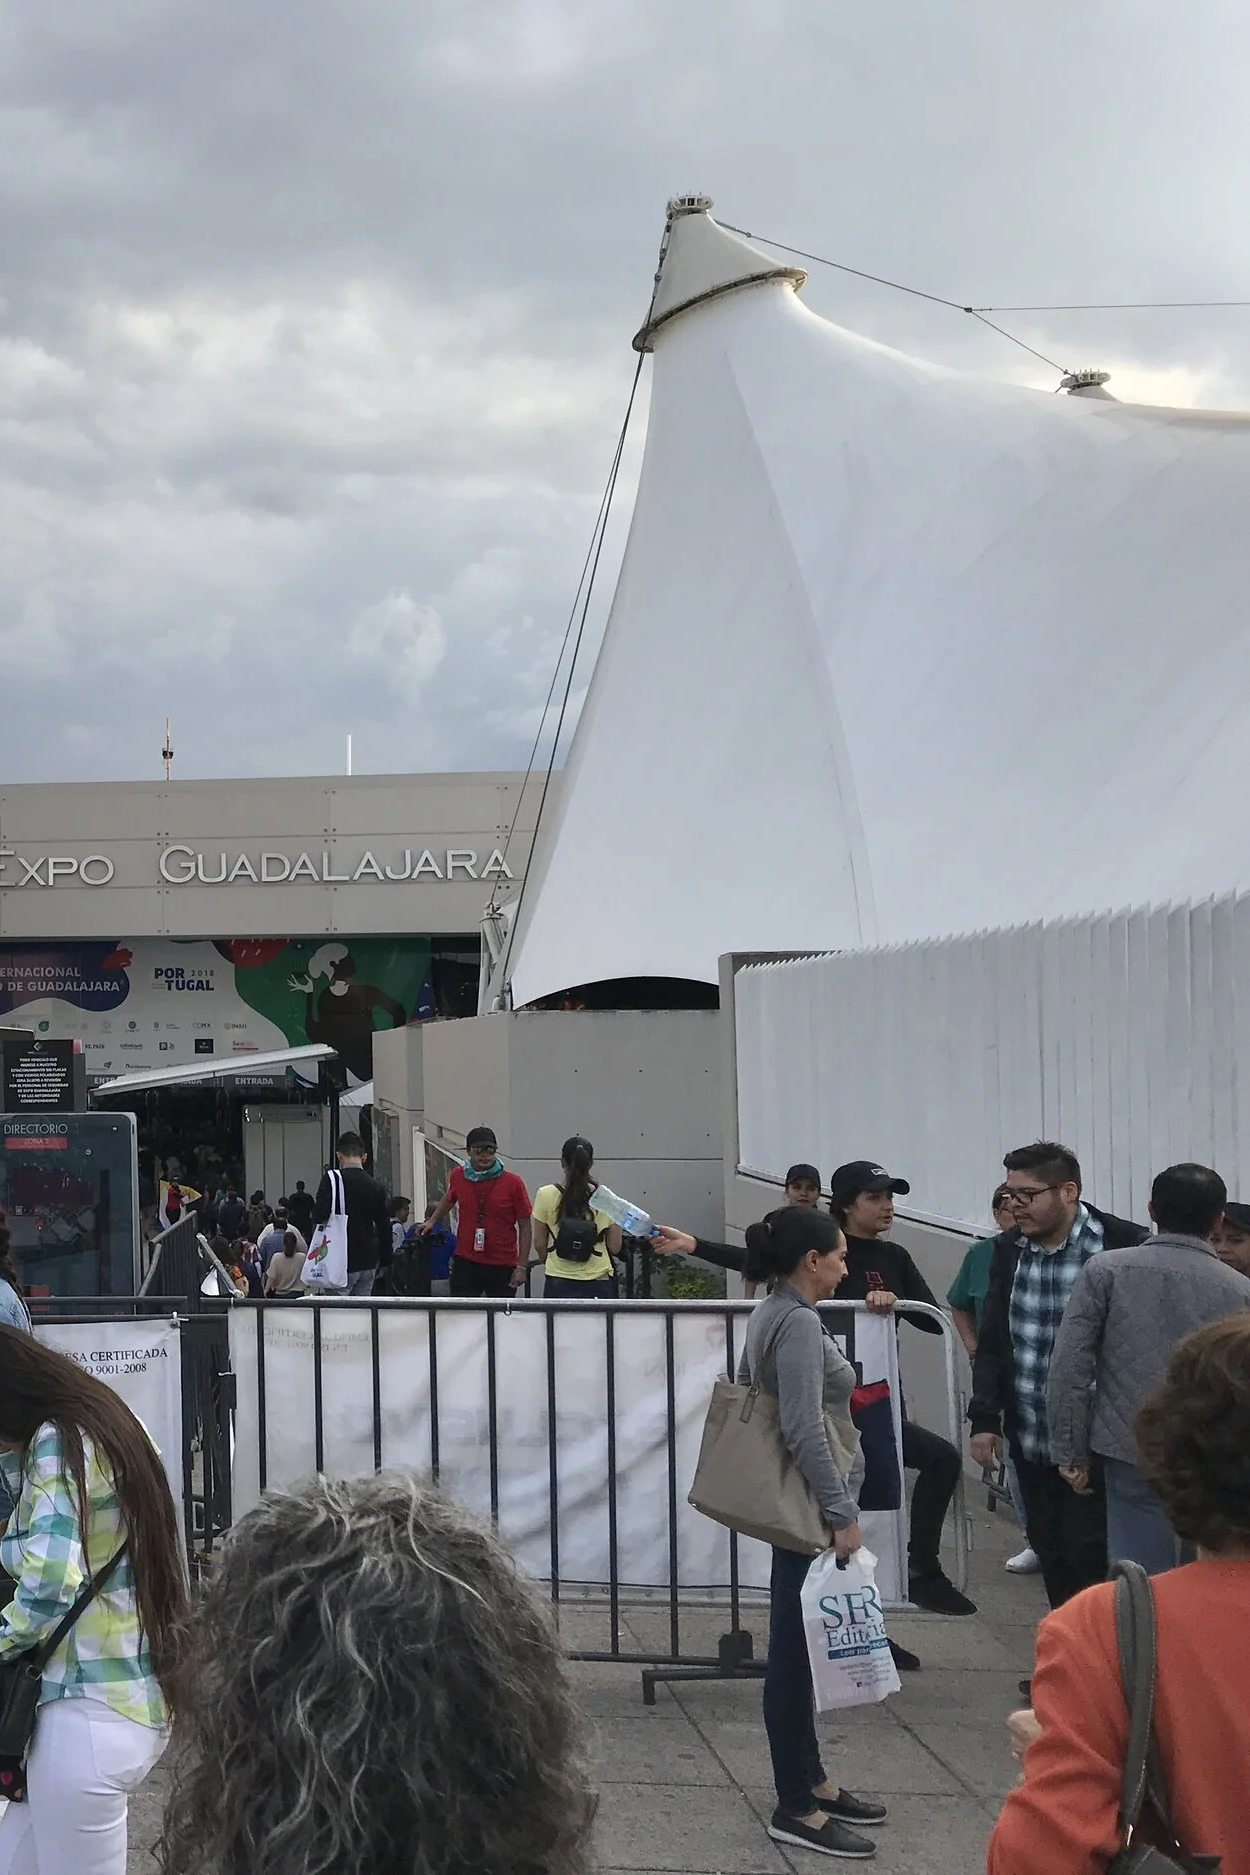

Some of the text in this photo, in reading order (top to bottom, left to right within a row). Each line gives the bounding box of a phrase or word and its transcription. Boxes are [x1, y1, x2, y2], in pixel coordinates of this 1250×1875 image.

[159, 844, 514, 884] GUADALAJARA
[154, 967, 185, 979] POR
[190, 969, 215, 977] 2018
[7, 981, 23, 992] DE
[27, 980, 120, 993] GUADALAJARA
[165, 979, 215, 991] TUGAL
[235, 1077, 274, 1085] ENTRADA
[4, 1123, 68, 1135] DIRECTORIO
[90, 1348, 168, 1362] CERTIFICADA
[95, 1363, 147, 1375] 9001-2008
